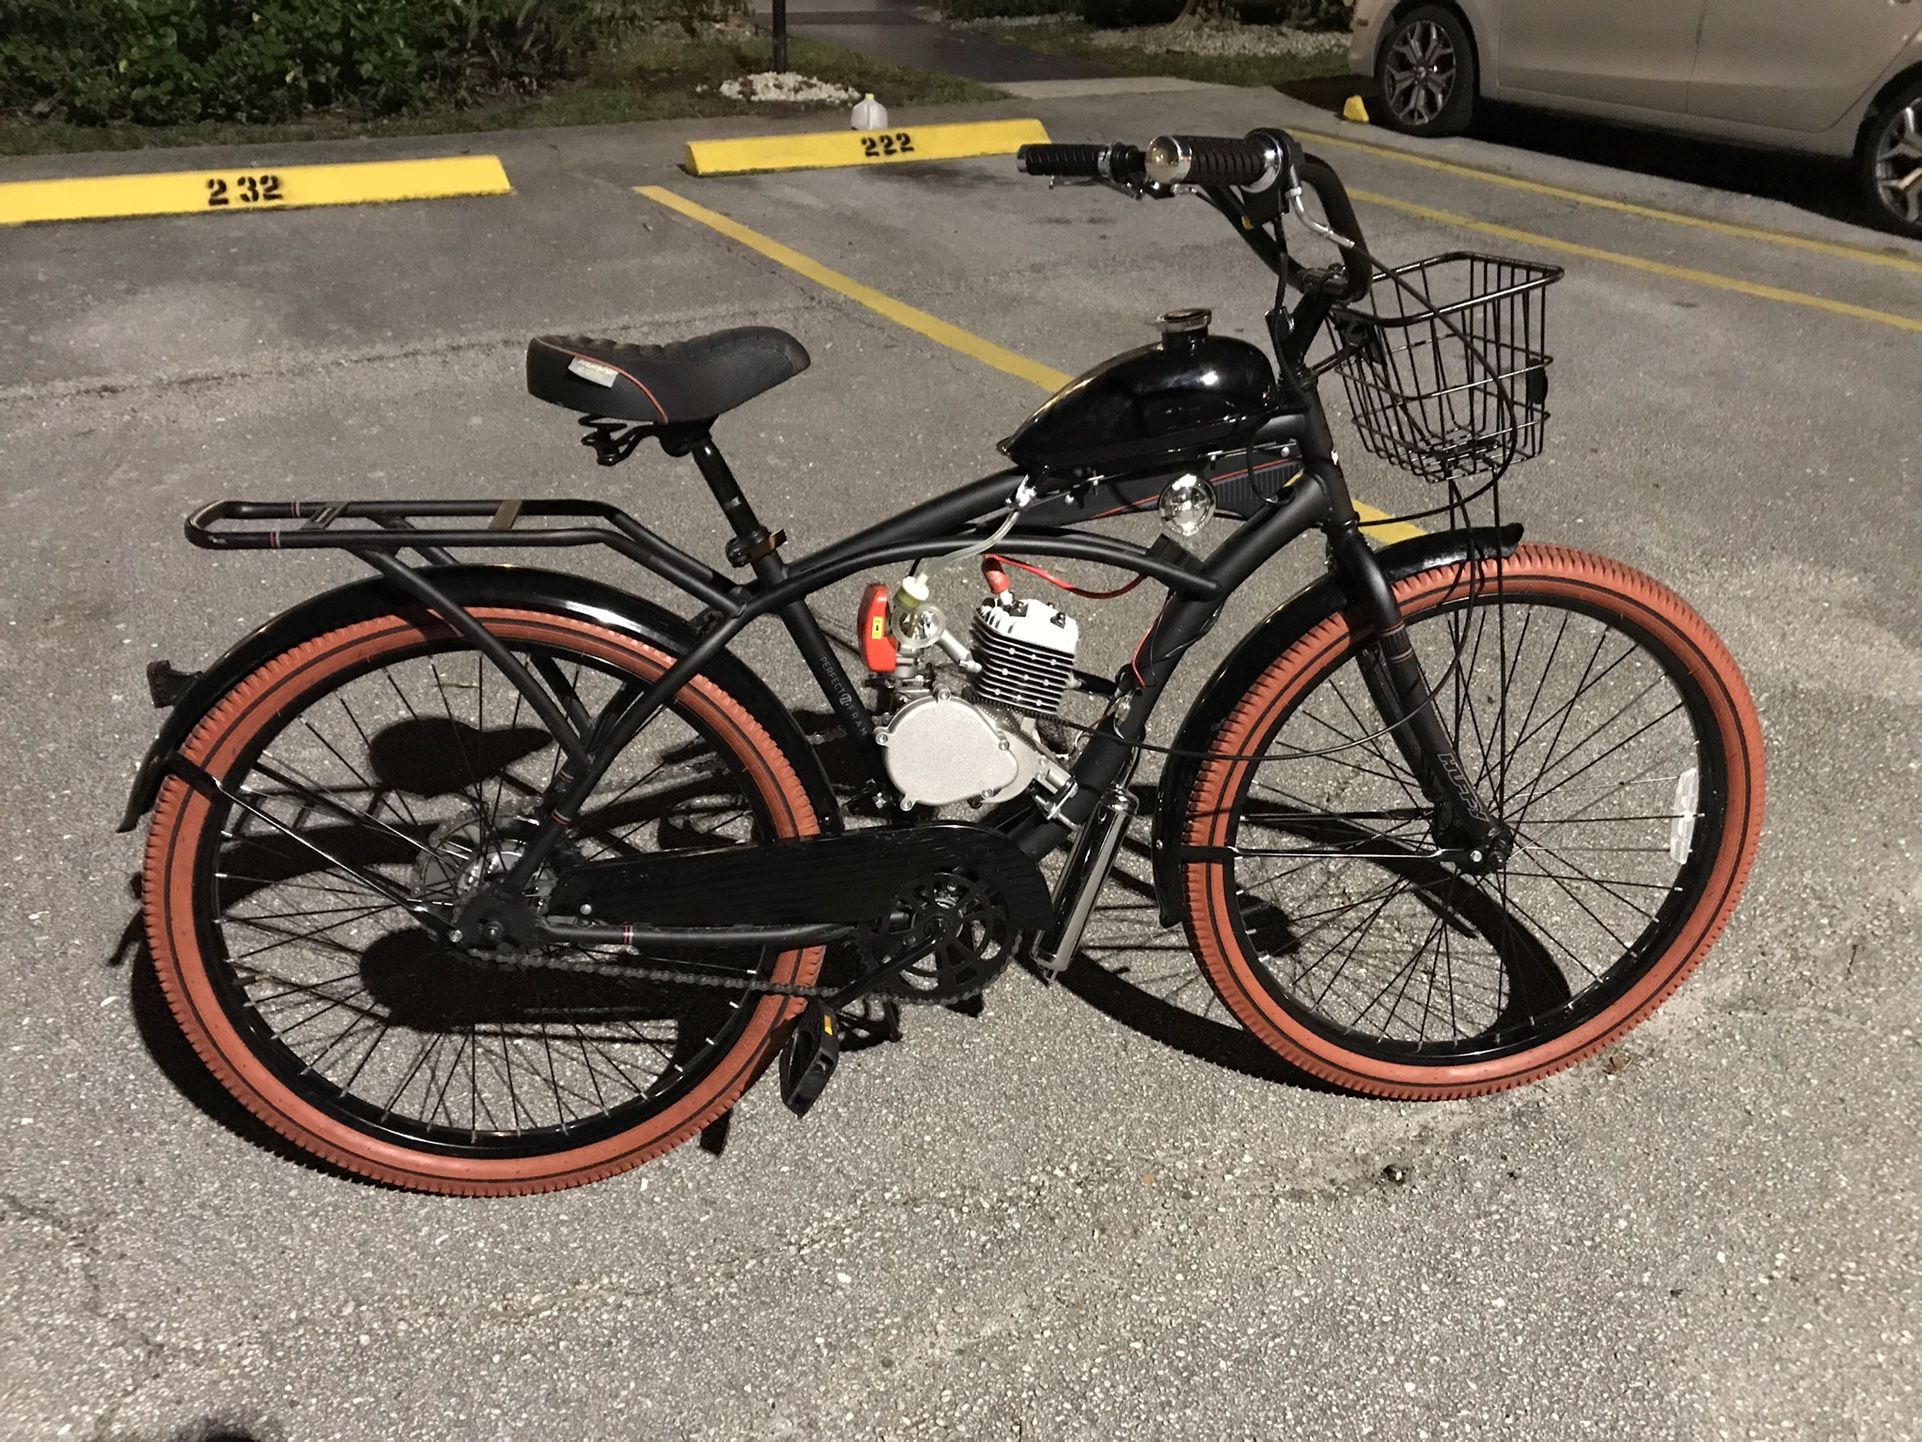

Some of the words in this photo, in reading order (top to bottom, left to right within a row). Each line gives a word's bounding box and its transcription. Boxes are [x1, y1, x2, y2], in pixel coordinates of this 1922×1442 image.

[861, 133, 914, 157] 222
[208, 175, 283, 206] 232
[820, 656, 846, 694] PERFECT
[1437, 752, 1489, 822] HUFFY
